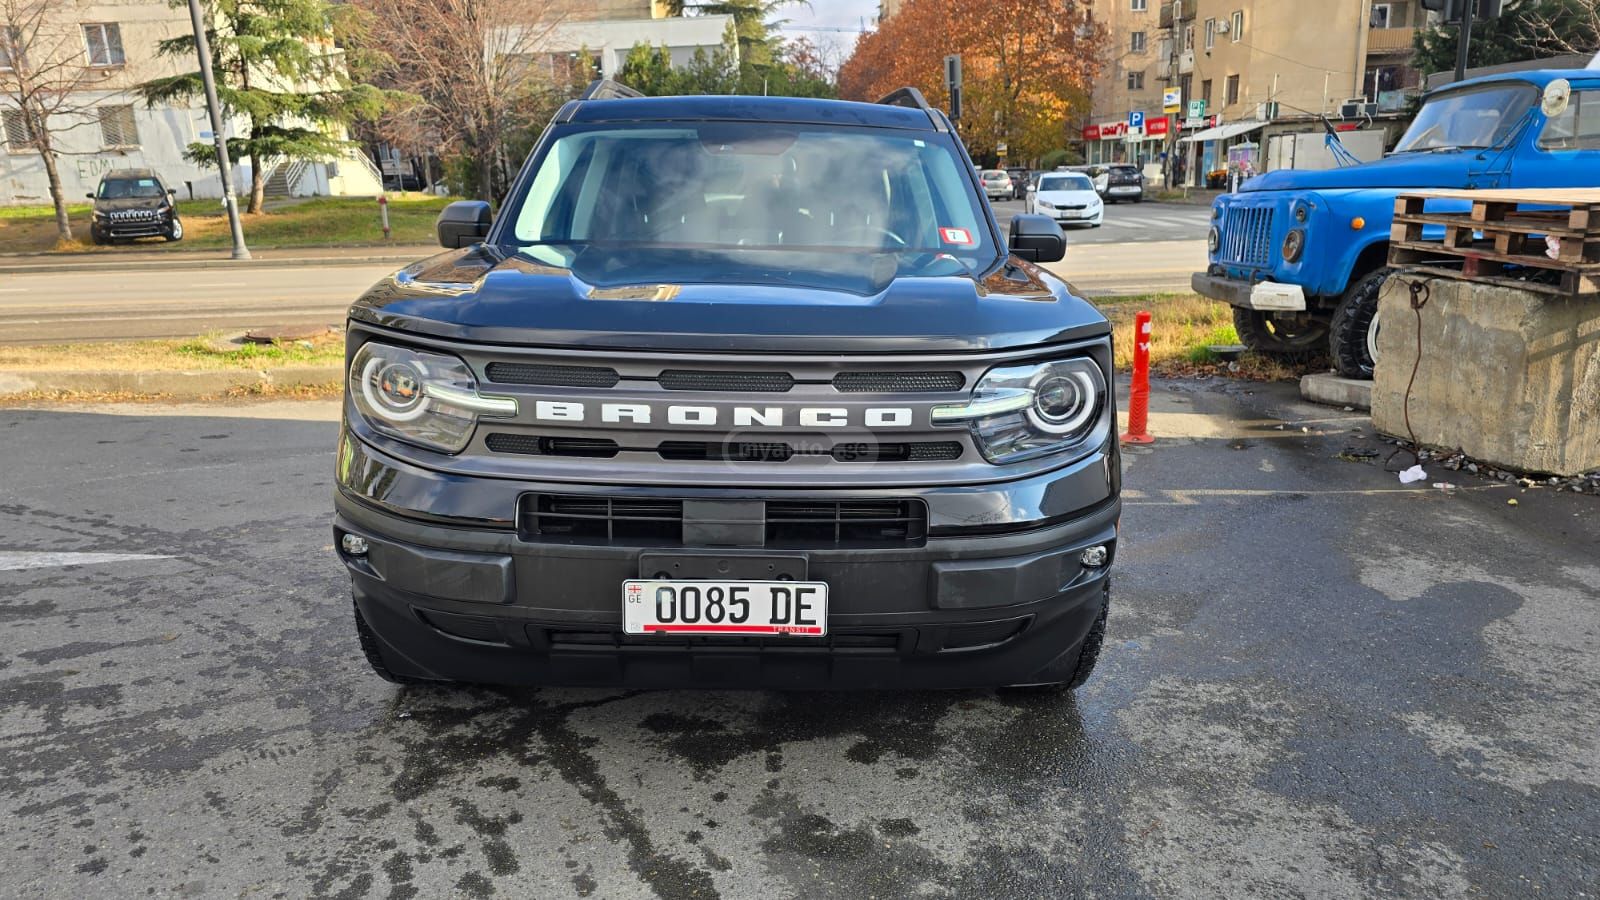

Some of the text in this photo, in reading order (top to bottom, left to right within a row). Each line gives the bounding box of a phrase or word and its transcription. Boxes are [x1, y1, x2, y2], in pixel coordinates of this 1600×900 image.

[1131, 112, 1141, 125] P
[535, 400, 913, 427] BRONCO
[628, 594, 642, 604] GE
[655, 586, 817, 625] 0085 DE
